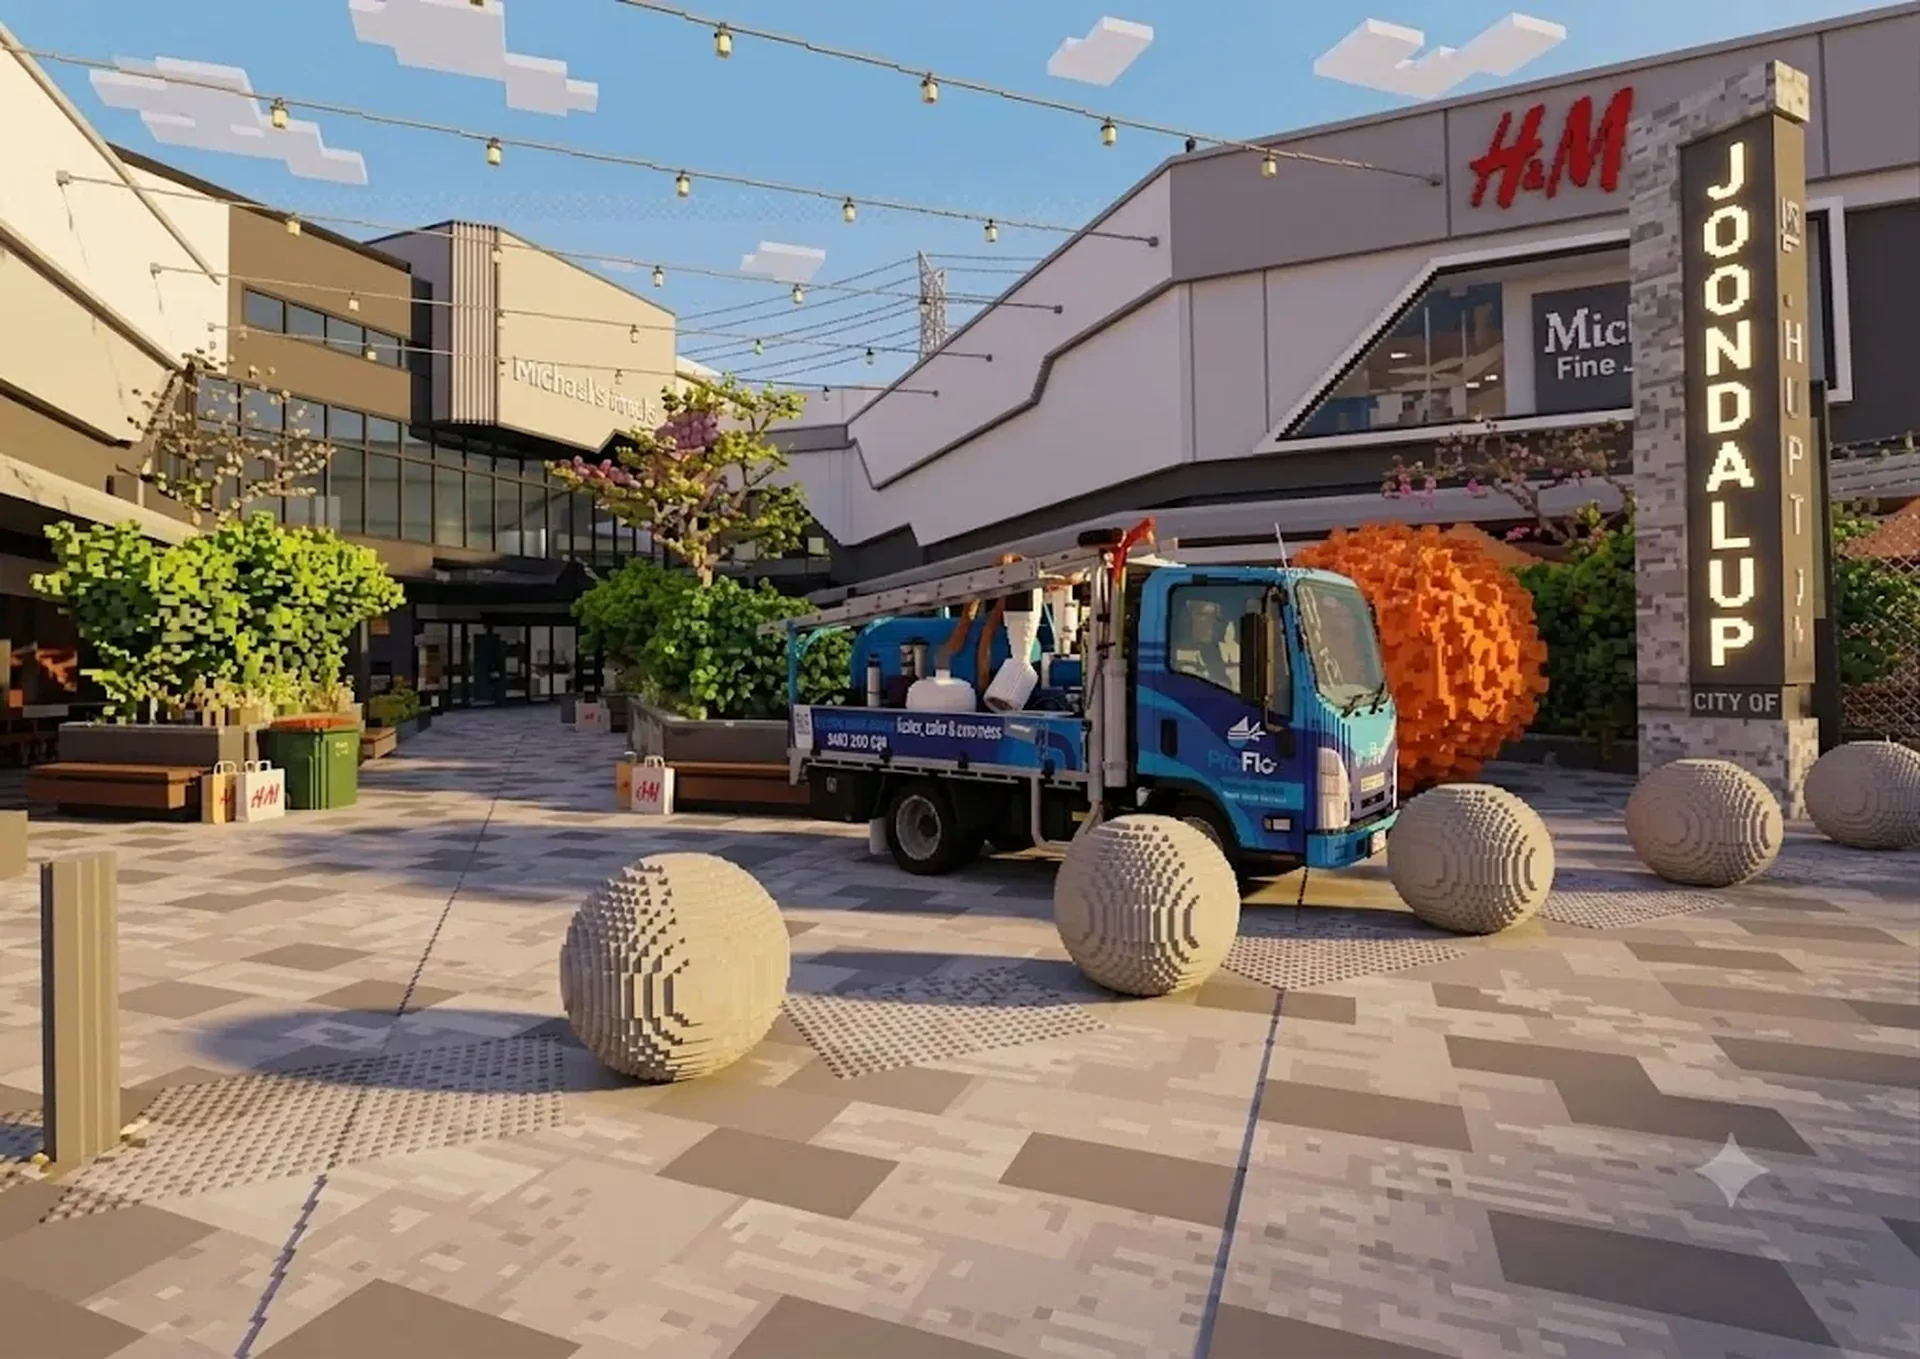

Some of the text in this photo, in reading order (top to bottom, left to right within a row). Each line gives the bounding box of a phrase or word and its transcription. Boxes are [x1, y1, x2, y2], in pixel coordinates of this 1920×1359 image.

[1470, 87, 1633, 209] H&M
[1557, 356, 1616, 380] Fine
[1703, 141, 1755, 667] JOONDALUP
[1694, 693, 1779, 713] CITY OF
